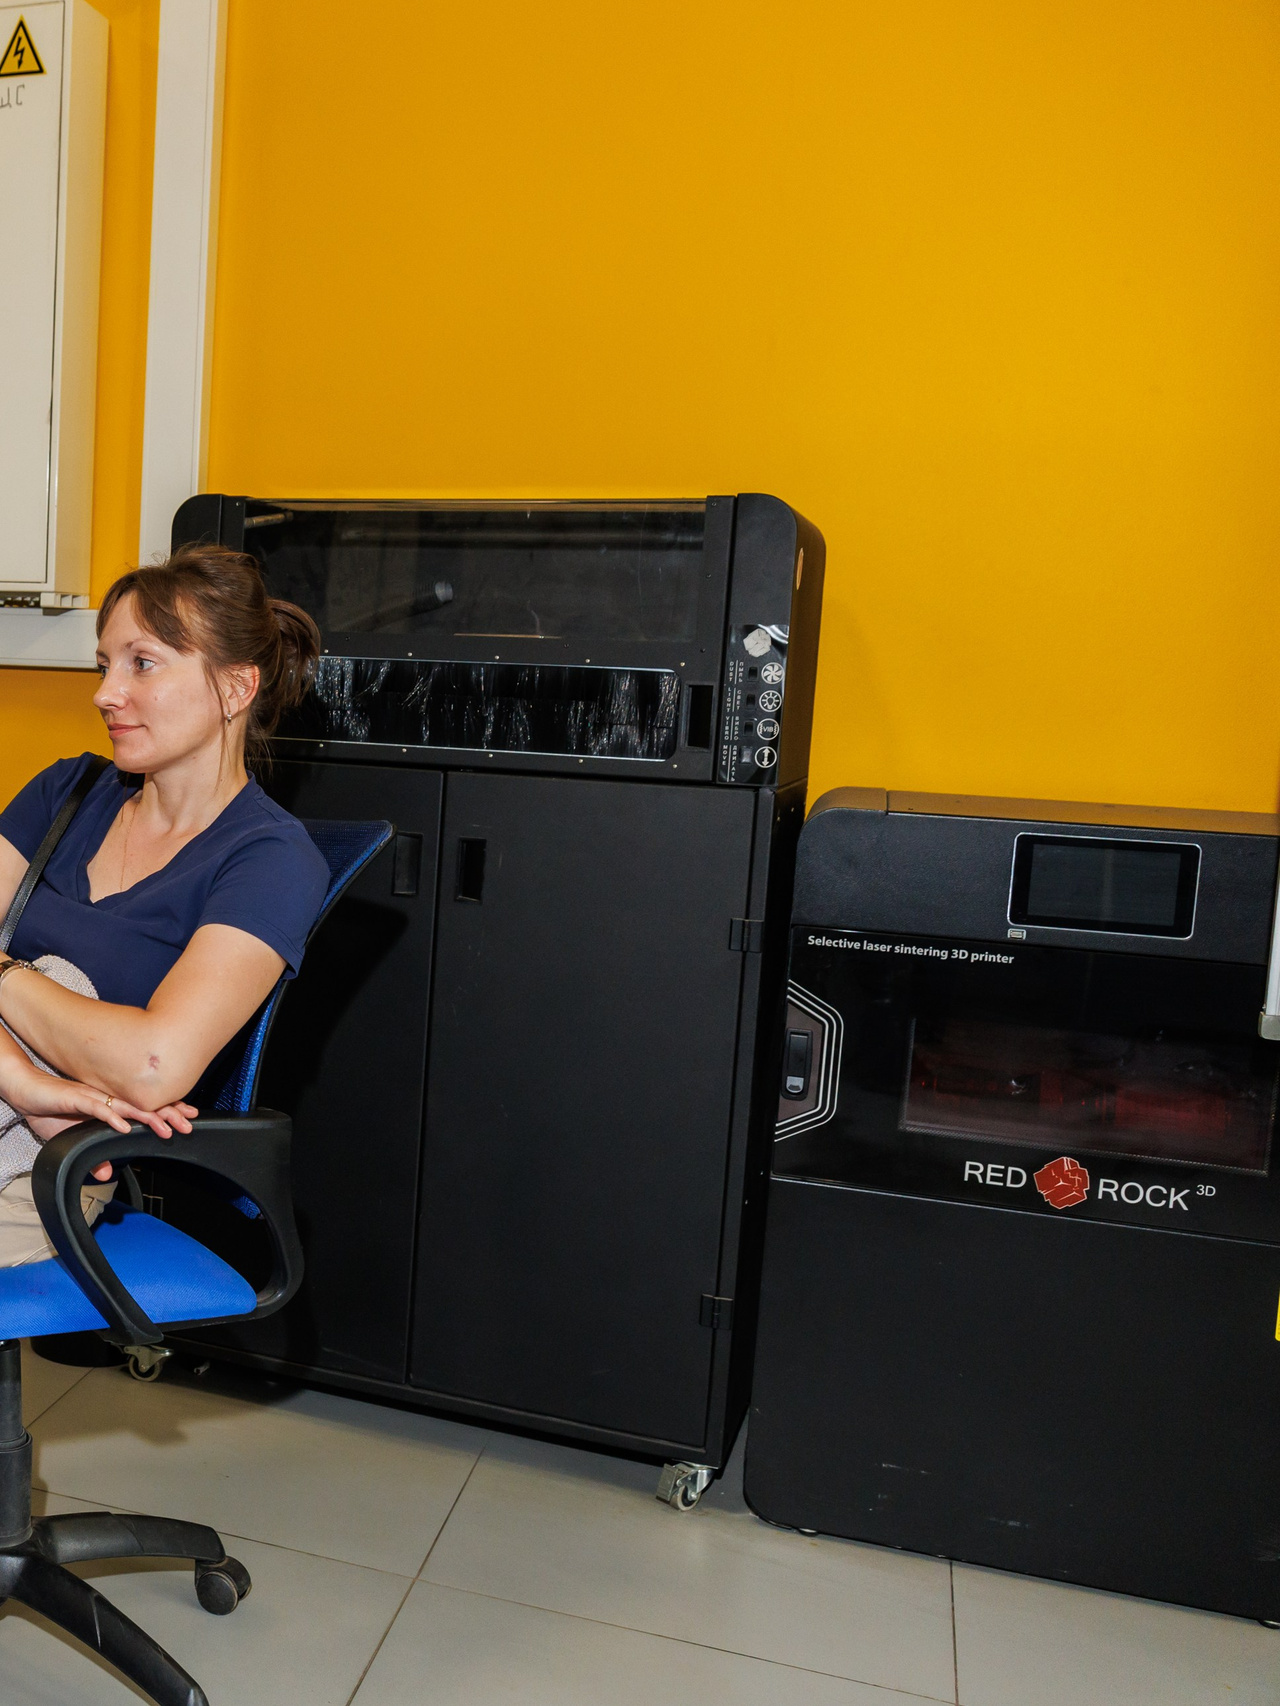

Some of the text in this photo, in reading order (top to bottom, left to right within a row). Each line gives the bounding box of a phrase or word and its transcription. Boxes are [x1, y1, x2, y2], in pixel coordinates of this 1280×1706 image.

[807, 935, 1015, 964] Selective laser sintering 3D printer
[963, 1160, 1216, 1211] RED ROCK 3D
